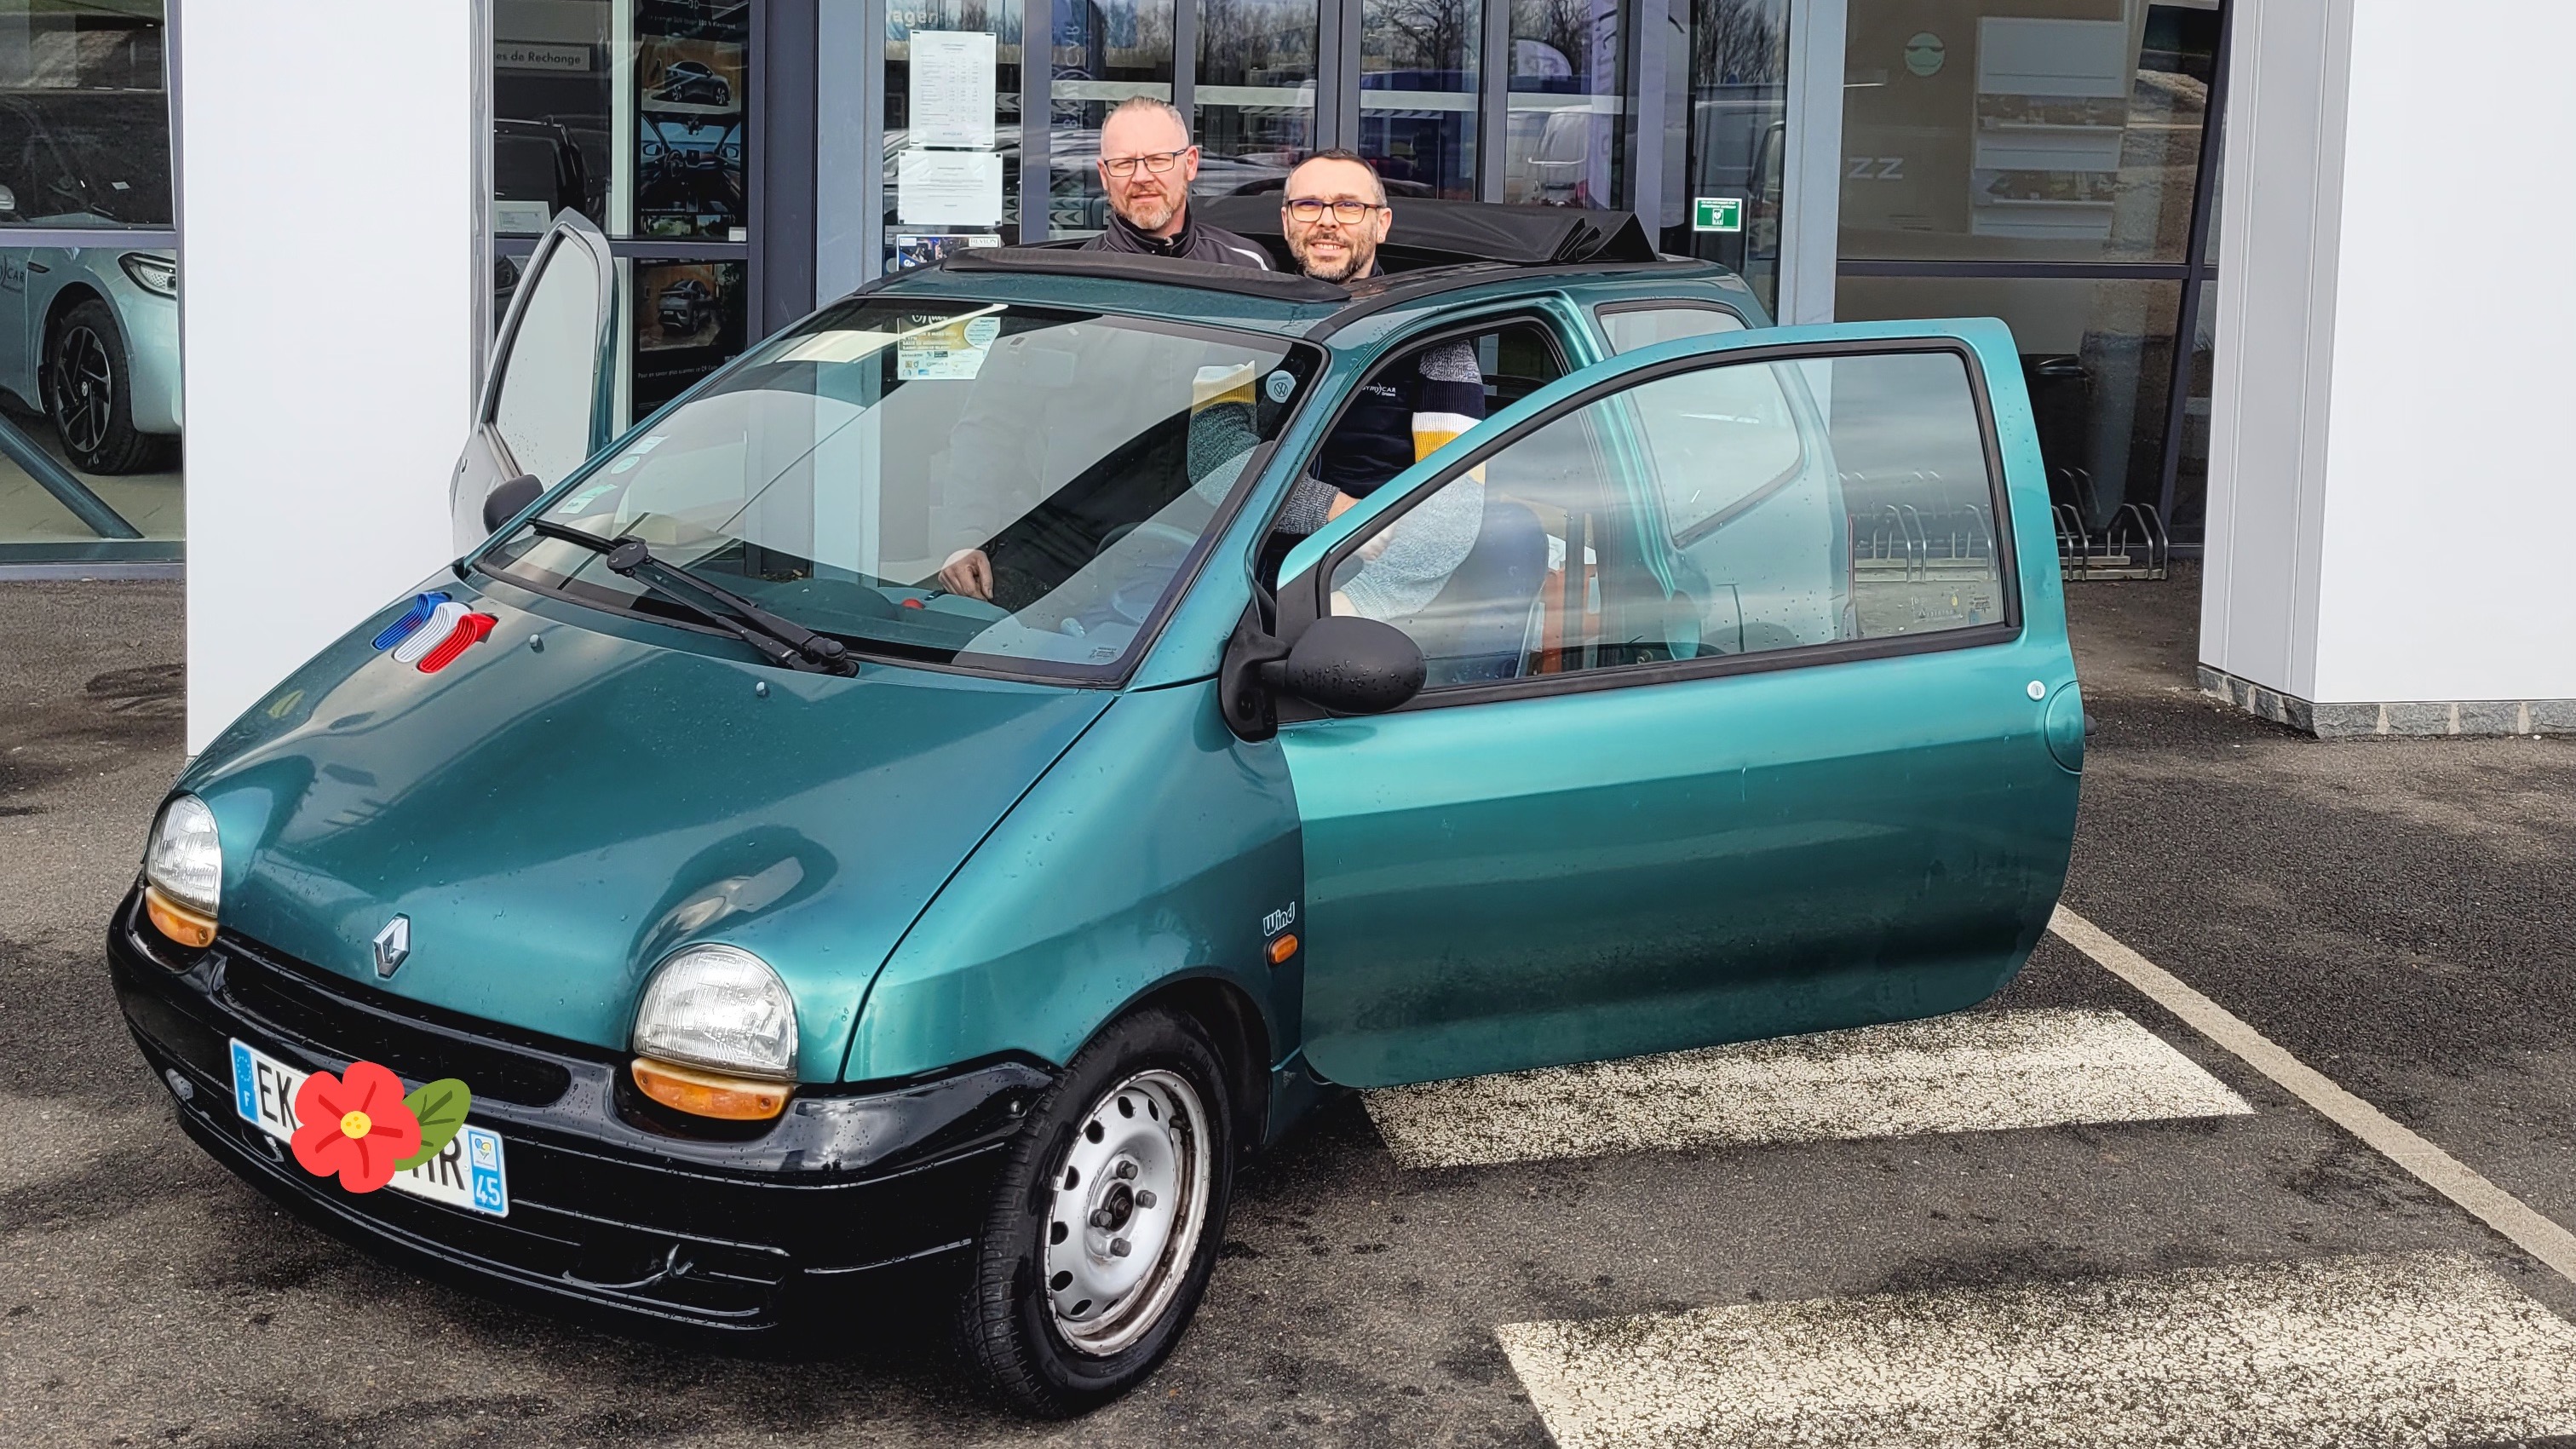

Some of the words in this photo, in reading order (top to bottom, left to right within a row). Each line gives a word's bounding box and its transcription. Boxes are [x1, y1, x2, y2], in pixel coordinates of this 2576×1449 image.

[510, 50, 524, 60] de
[528, 51, 582, 66] Rechange
[1262, 901, 1296, 937] Wind
[244, 1090, 250, 1107] F
[256, 1060, 297, 1131] EK
[475, 1174, 501, 1206] 45
